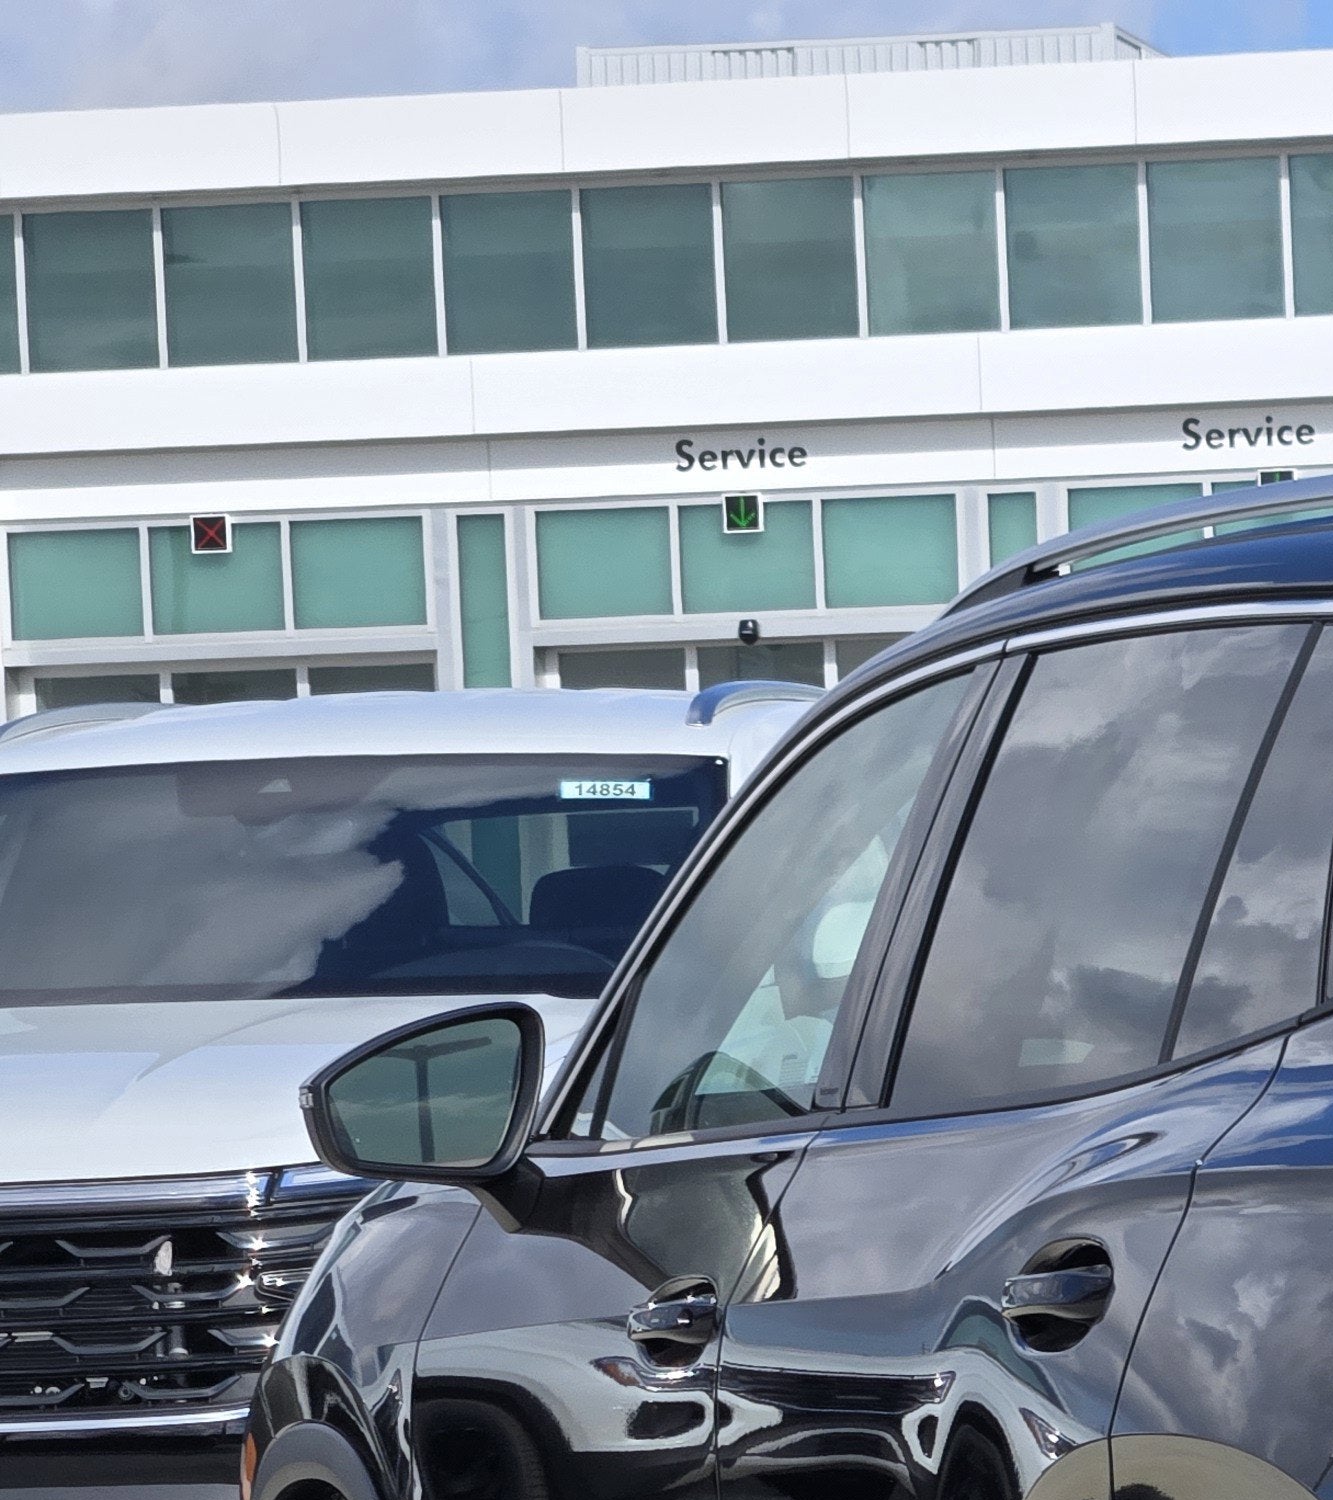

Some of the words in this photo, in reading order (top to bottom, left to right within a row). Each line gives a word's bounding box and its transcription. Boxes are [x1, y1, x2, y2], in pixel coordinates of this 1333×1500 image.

[1182, 415, 1315, 451] Service
[675, 437, 807, 472] Service
[574, 783, 637, 797] 14854
